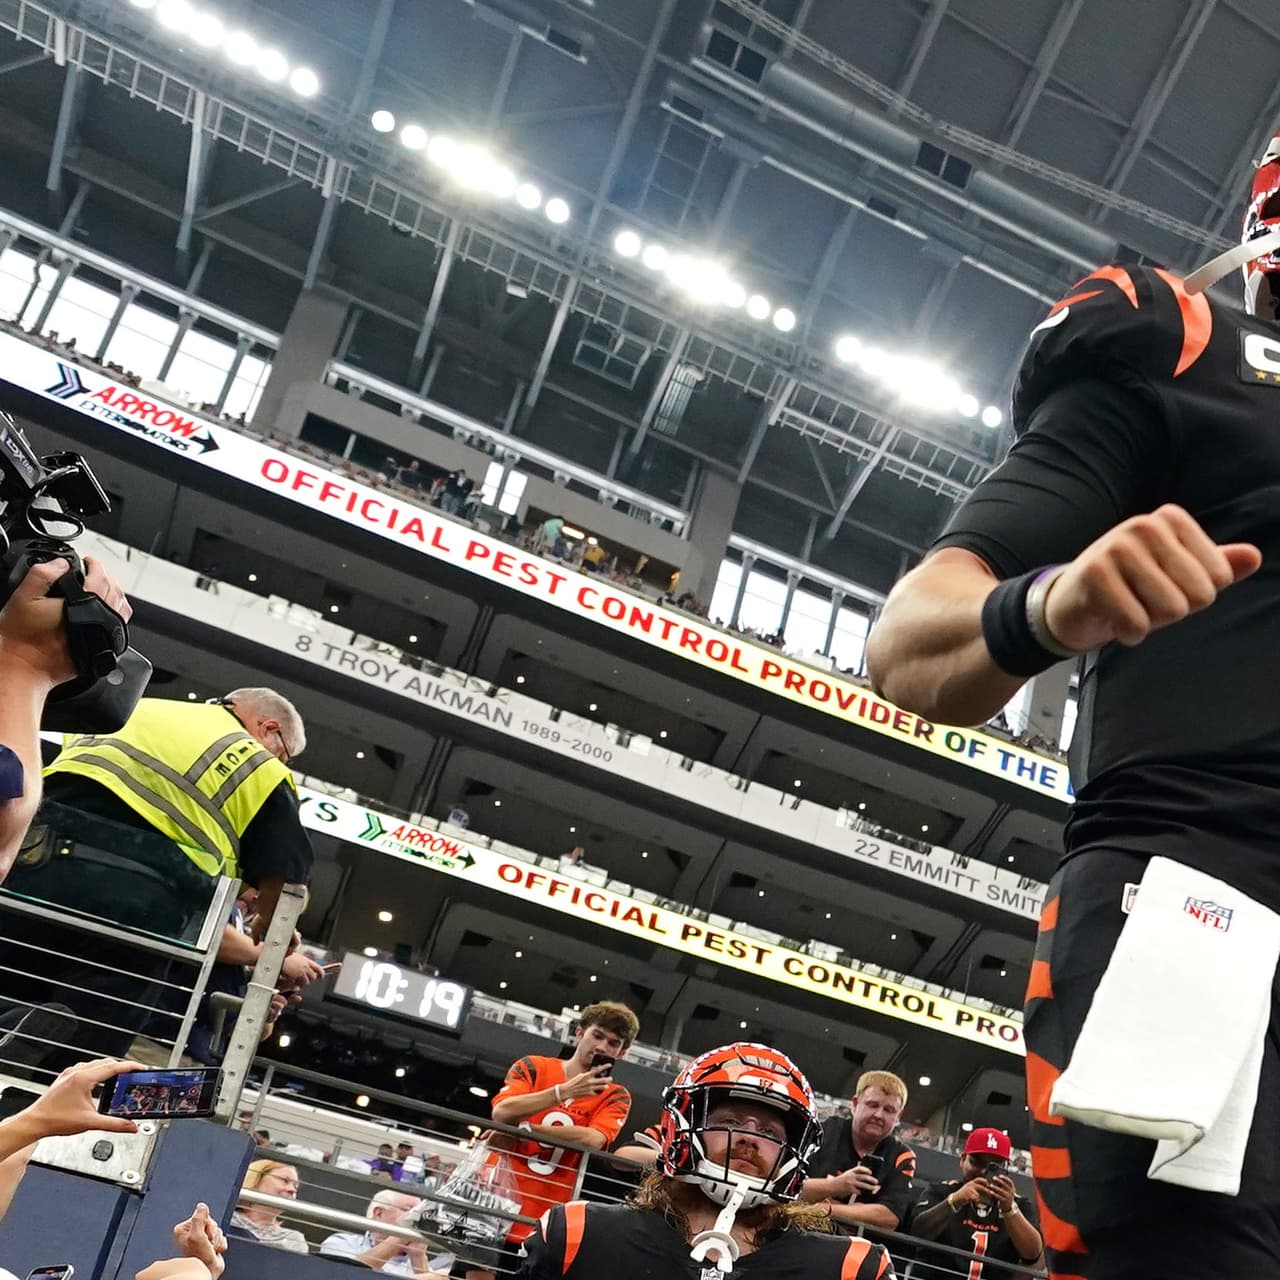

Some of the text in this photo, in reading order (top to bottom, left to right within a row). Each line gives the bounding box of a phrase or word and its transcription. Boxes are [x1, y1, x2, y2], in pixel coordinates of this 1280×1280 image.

[90, 385, 205, 438] ARROW
[260, 457, 1060, 790] OFFICIAL PEST CONTROL PROVIDER OF THE
[294, 634, 314, 653] 8
[321, 642, 401, 683] TROY
[402, 676, 515, 729] AIKMAN
[388, 824, 466, 859] ARROW
[854, 838, 1042, 915] 22 EMMITT SMIT
[497, 863, 667, 936] OFFICIAL
[681, 923, 773, 967] PEST
[783, 956, 944, 1022] CONTROL
[354, 960, 466, 1027] 10:19
